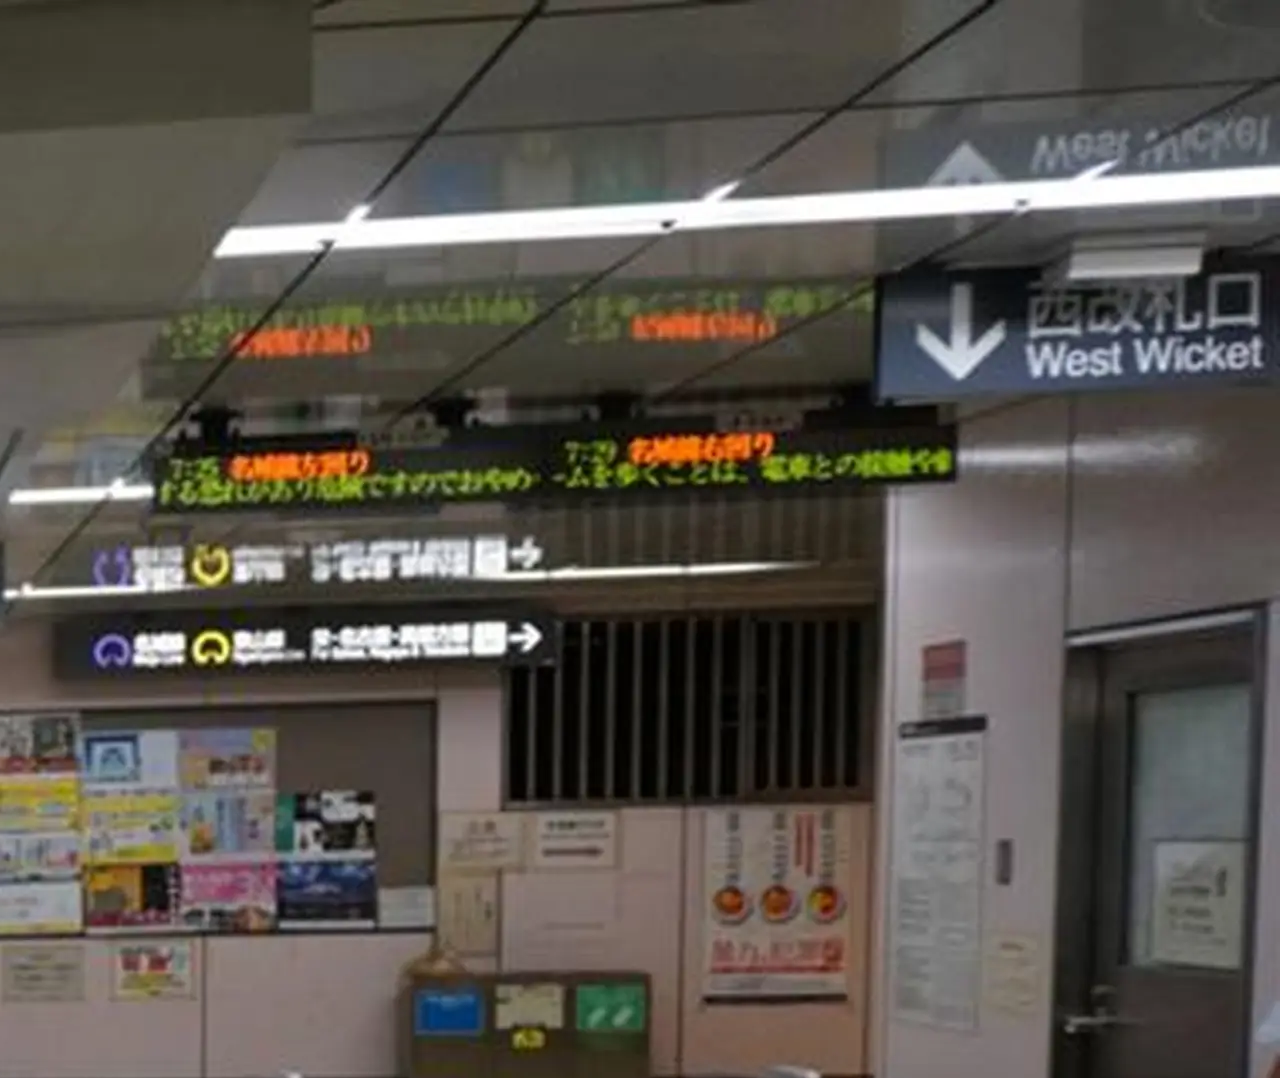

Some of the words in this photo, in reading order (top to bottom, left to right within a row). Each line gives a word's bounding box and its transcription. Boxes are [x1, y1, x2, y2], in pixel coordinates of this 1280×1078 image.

[1027, 272, 1261, 338] 西改札口
[1024, 341, 1124, 379] West
[1134, 336, 1263, 373] Wicket
